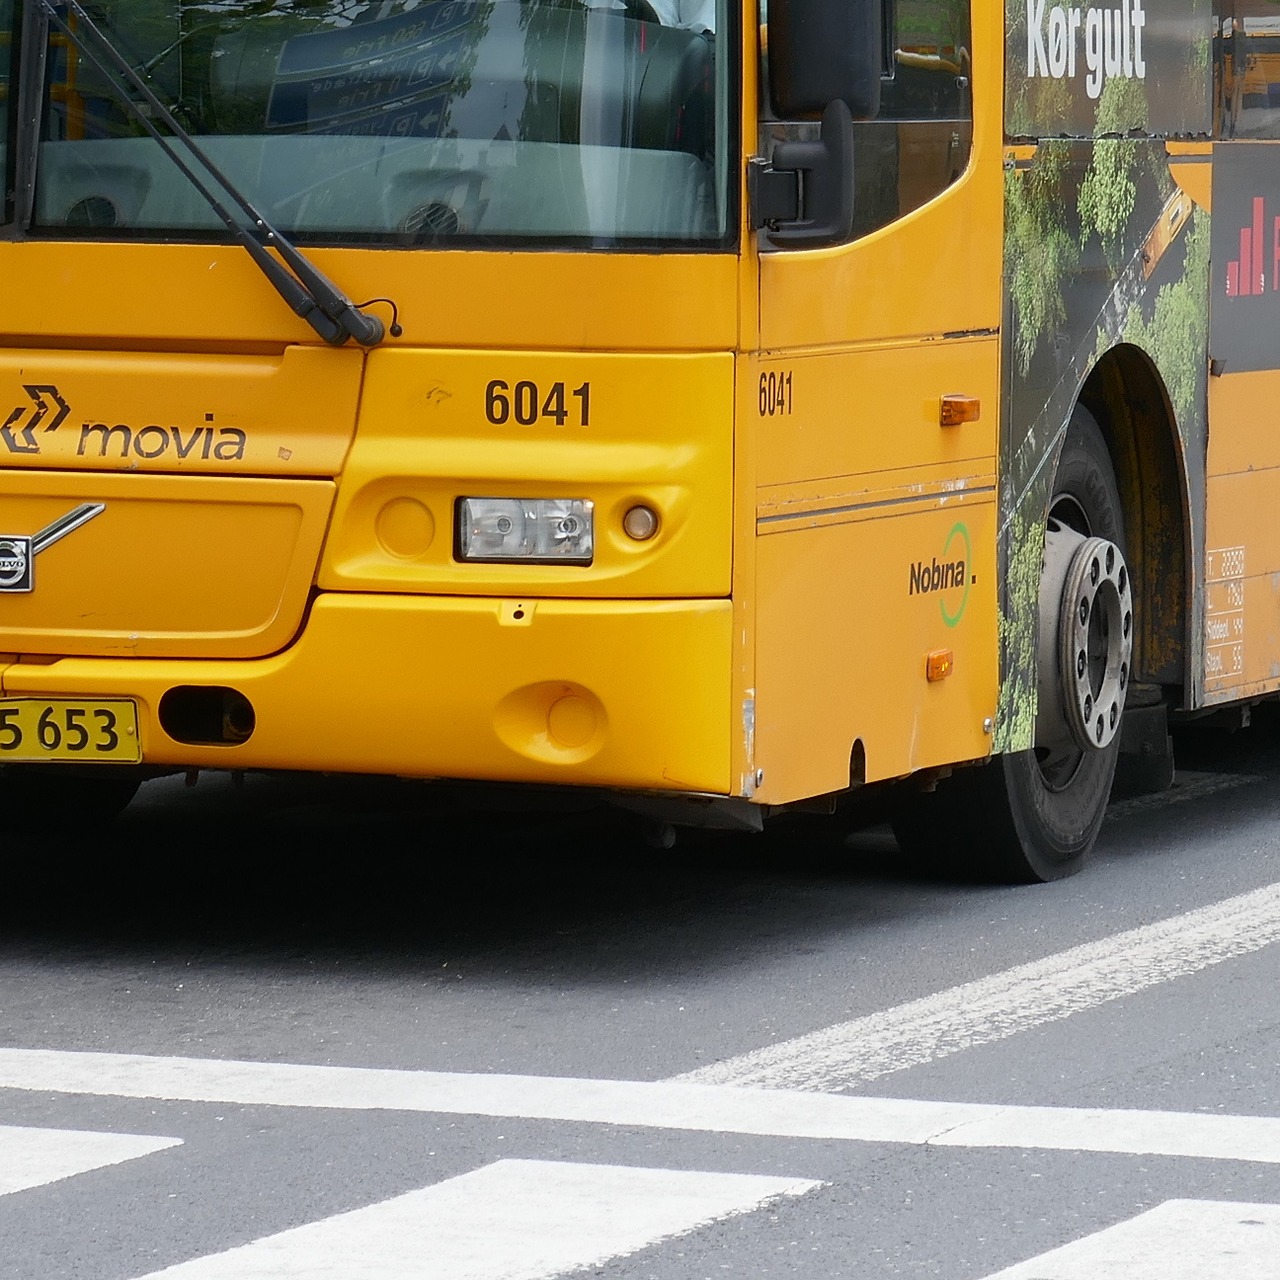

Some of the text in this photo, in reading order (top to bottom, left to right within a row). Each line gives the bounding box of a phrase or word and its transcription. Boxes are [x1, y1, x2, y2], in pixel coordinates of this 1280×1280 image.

[485, 379, 590, 426] 6041
[758, 370, 792, 417] 6041
[75, 412, 248, 461] movia
[37, 706, 119, 752] 653
